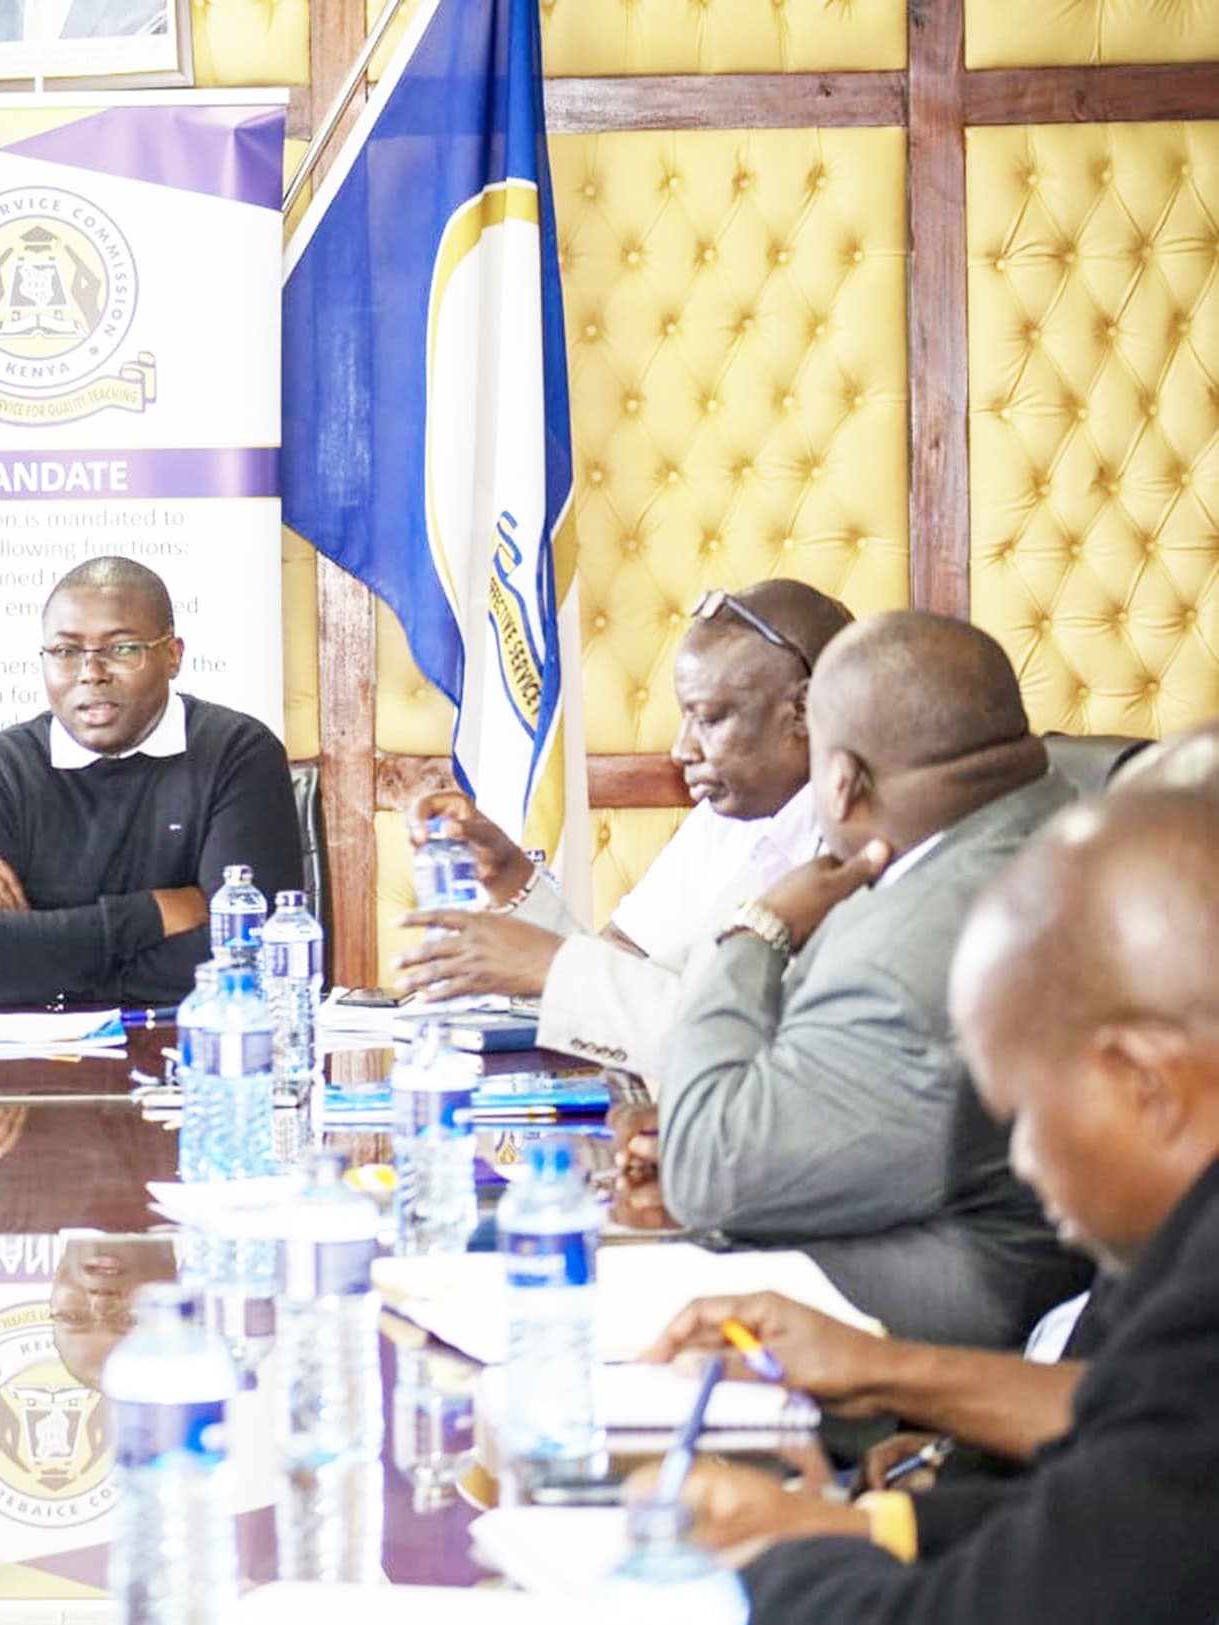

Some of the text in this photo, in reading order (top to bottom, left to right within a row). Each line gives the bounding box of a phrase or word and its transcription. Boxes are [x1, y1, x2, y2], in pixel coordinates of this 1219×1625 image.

[72, 207, 128, 337] COMMISSION
[5, 361, 71, 379] KENYA
[25, 404, 46, 418] FOR
[25, 509, 40, 527] is
[46, 508, 156, 527] mandated
[164, 509, 185, 527] to
[192, 654, 227, 673] the
[11, 685, 39, 704] for
